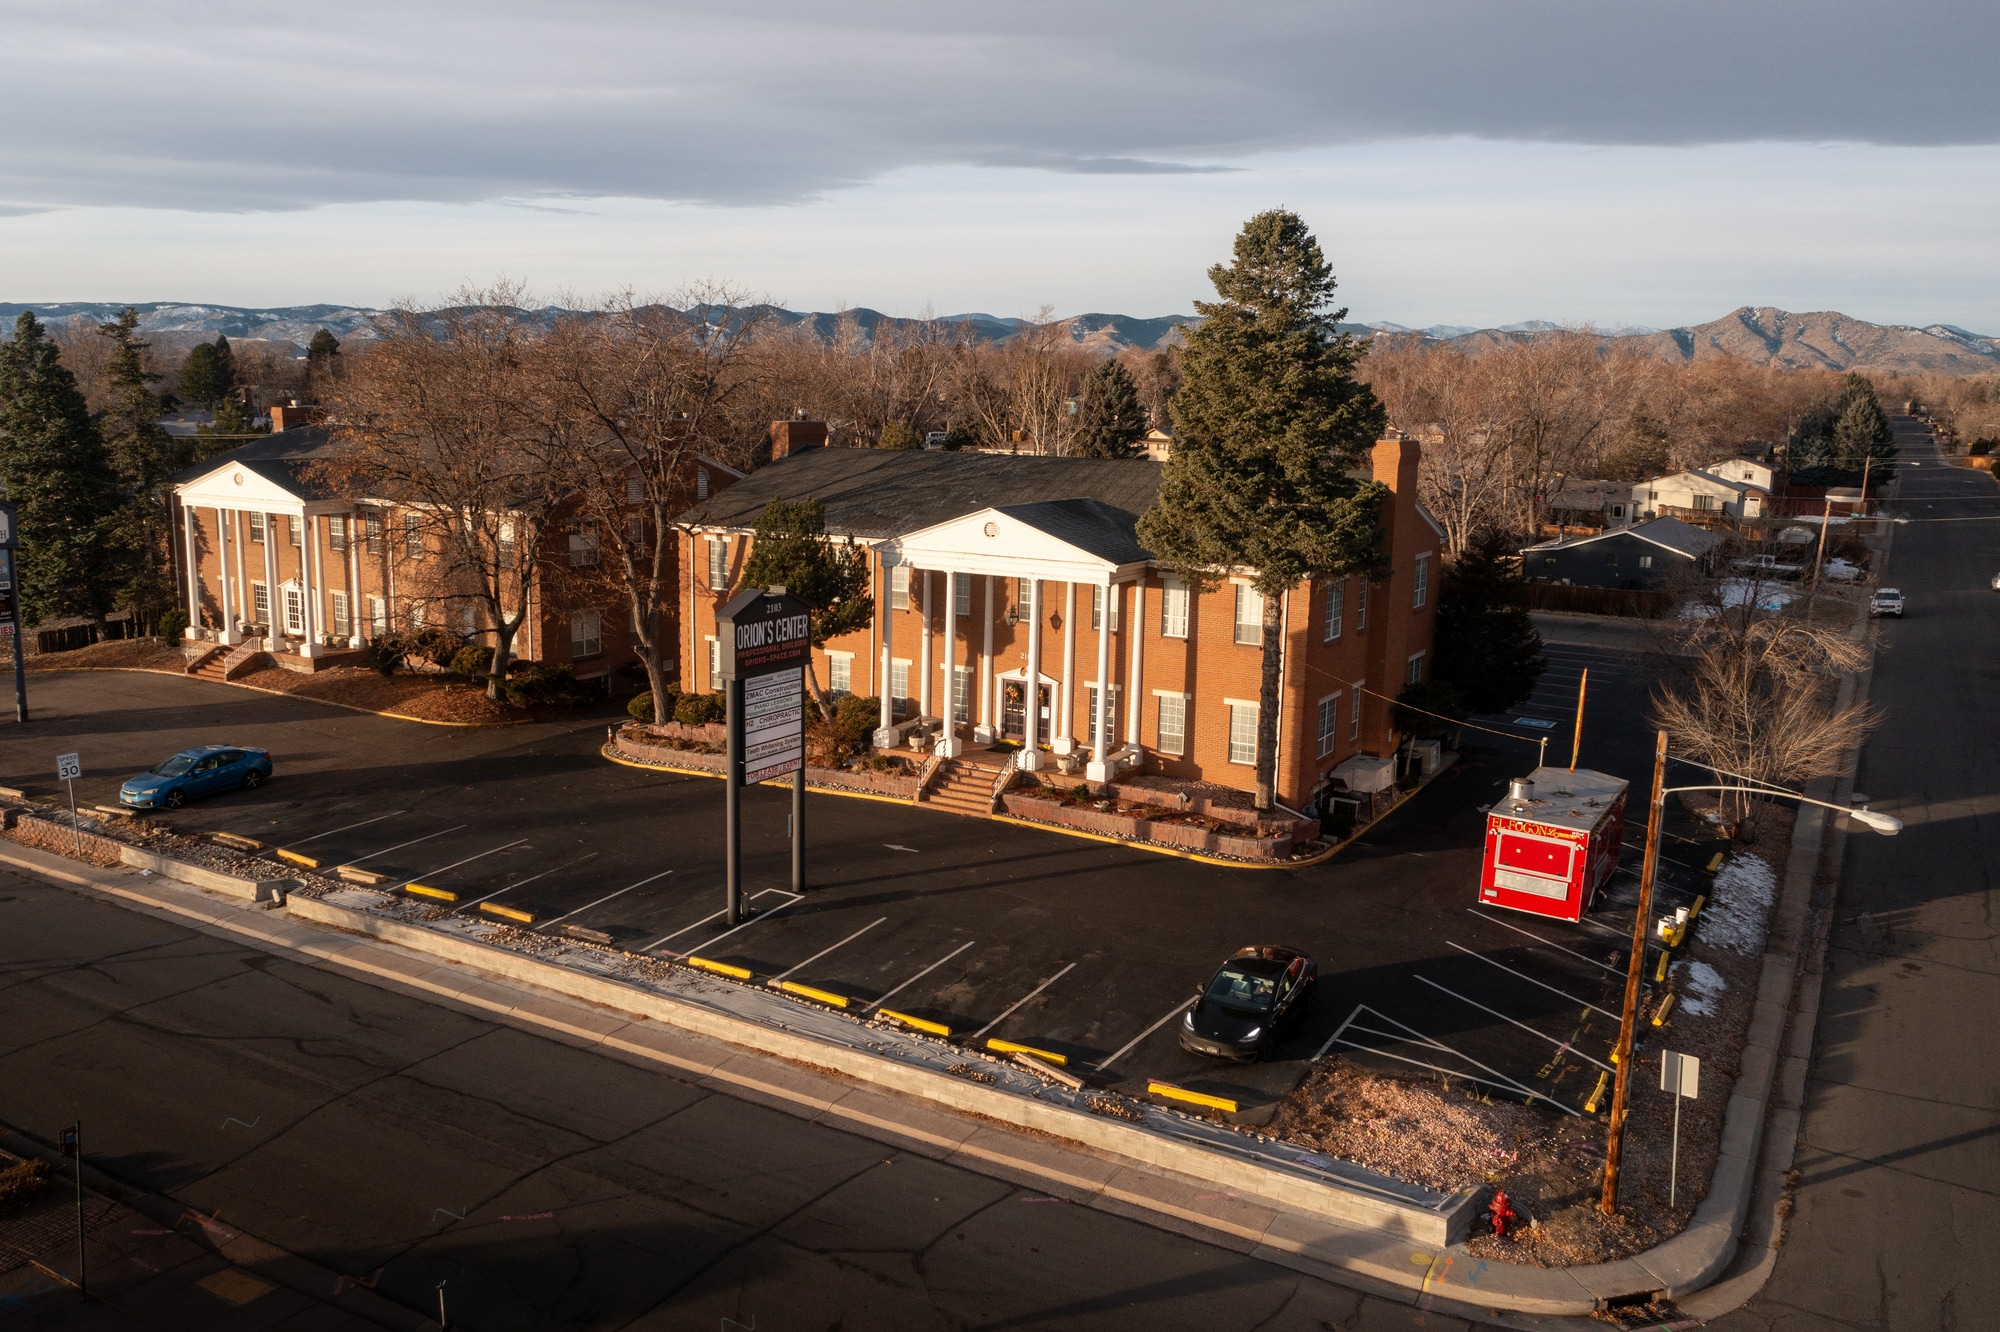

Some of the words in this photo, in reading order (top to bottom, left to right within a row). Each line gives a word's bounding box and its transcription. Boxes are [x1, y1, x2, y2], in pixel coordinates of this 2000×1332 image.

[766, 603, 782, 614] 2103
[737, 620, 774, 650] ORION'S
[776, 614, 808, 642] CENTER
[737, 644, 780, 659] PROFESSIONAL
[781, 638, 808, 650] BUILDING
[746, 689, 764, 700] ZMAC
[765, 682, 801, 695] Construction
[754, 702, 770, 710] PIANO
[770, 696, 793, 707] LESSONS
[759, 708, 801, 725] CHIROPRACTIC
[61, 766, 78, 777] 30
[747, 770, 760, 780] FOR
[760, 764, 779, 776] LEASE
[1491, 817, 1506, 829] EL
